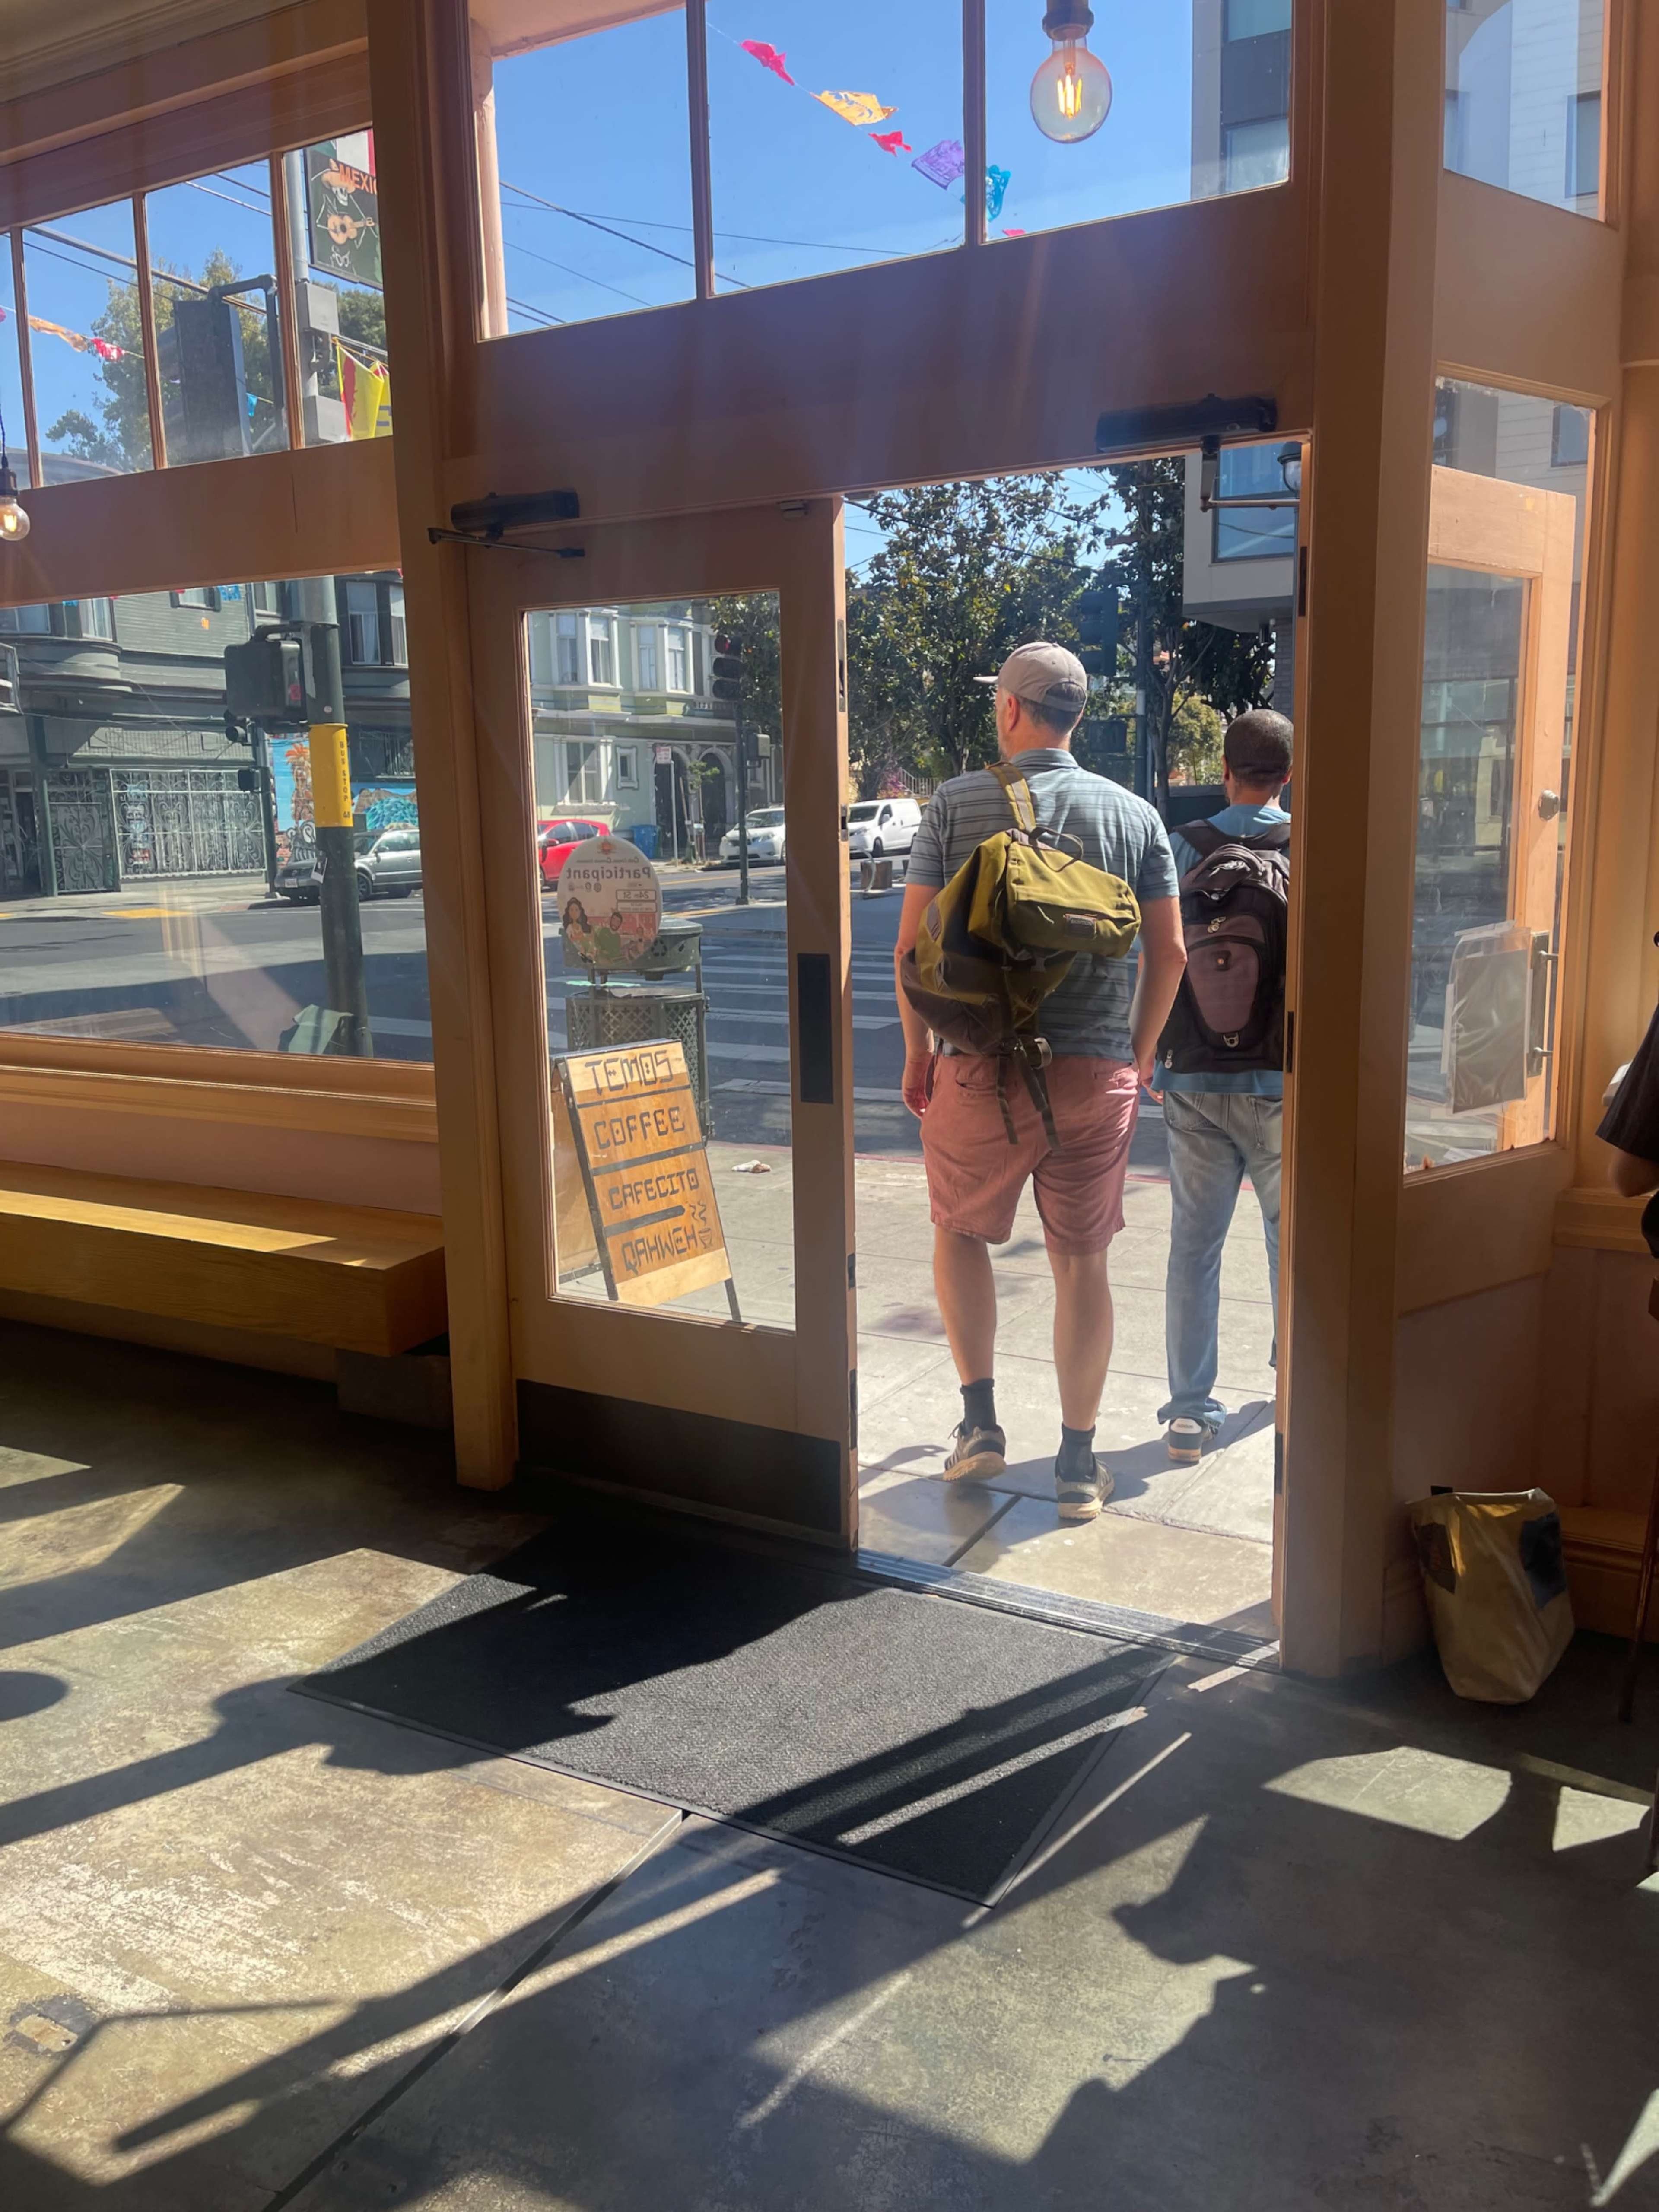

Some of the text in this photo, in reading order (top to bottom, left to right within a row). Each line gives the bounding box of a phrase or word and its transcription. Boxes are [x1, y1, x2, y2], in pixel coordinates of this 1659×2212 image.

[584, 1050, 673, 1096] TEMOS
[594, 1106, 685, 1150] COFFEE
[609, 1168, 699, 1210] CAFECITO
[622, 1224, 698, 1276] QAHWEH
